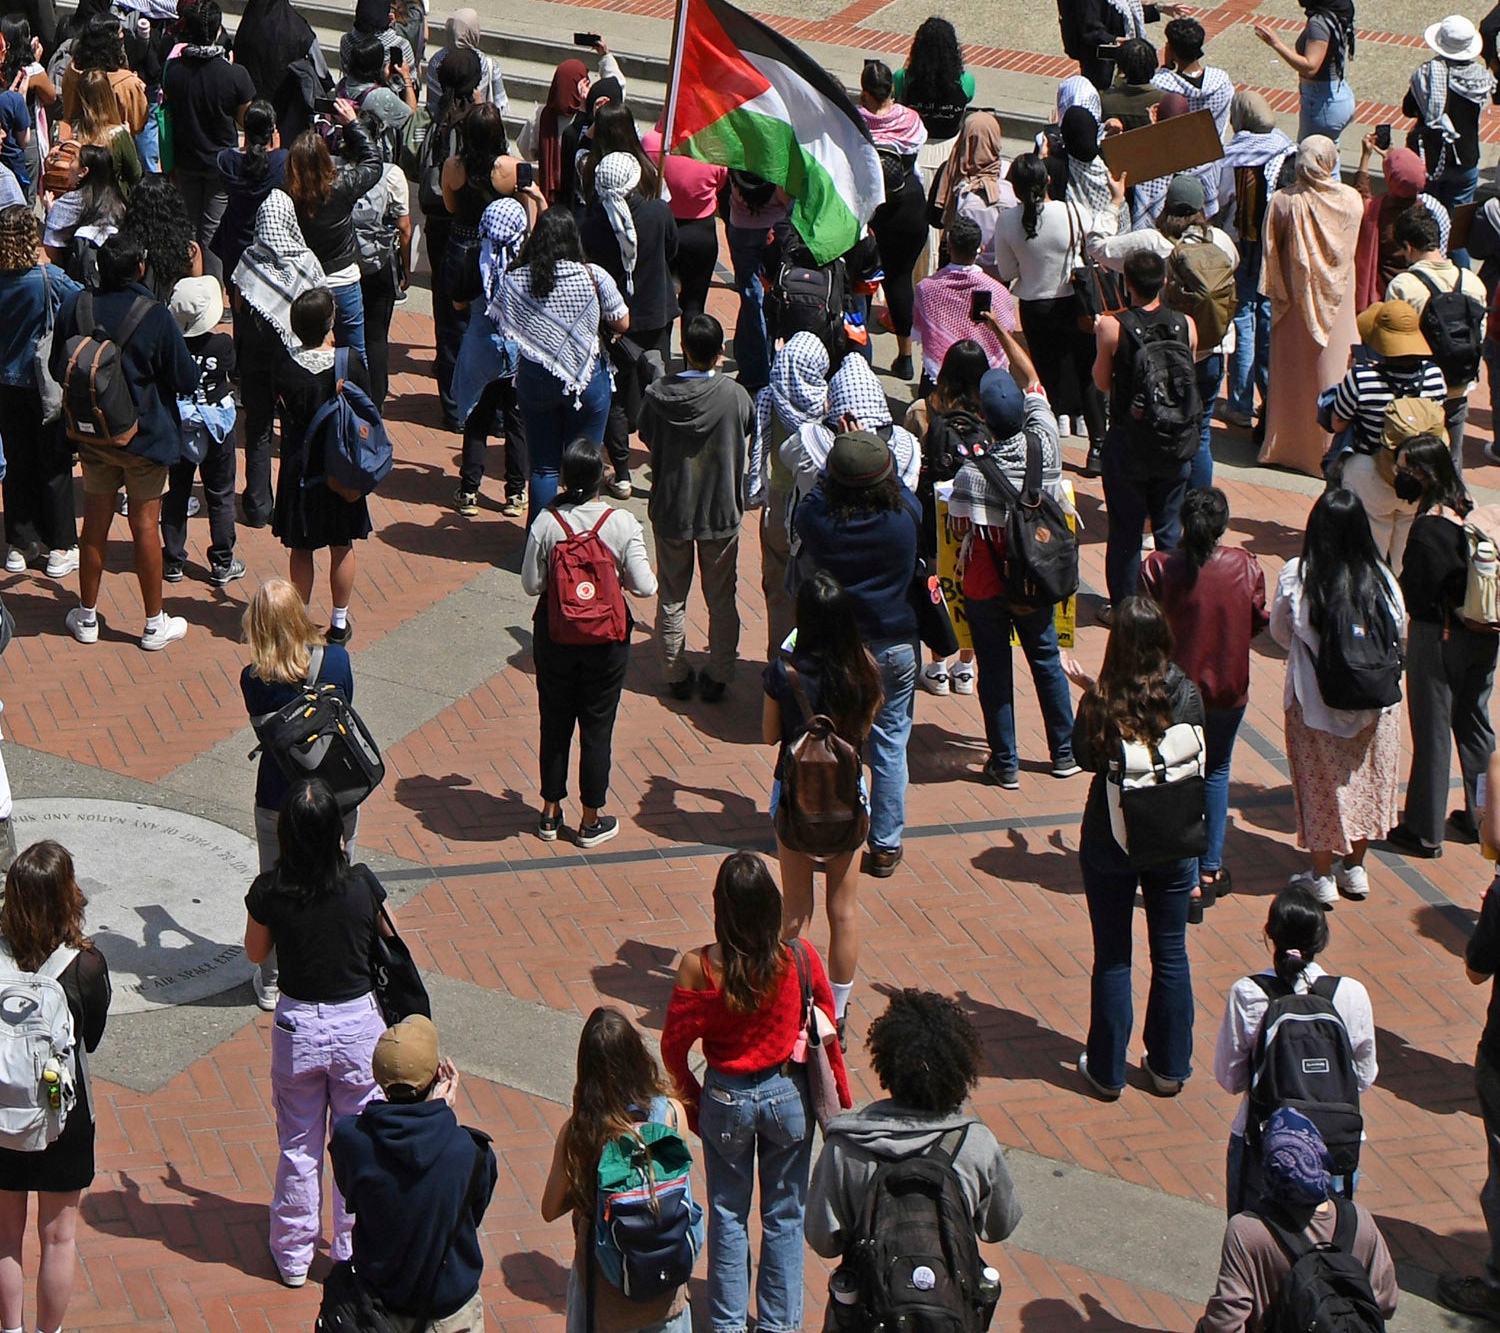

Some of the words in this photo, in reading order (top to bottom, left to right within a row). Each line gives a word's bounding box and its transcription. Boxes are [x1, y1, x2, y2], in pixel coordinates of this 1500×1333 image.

[43, 813, 71, 822] AND
[77, 813, 127, 826] NATION
[134, 820, 160, 830] ANY
[163, 827, 179, 836] OF
[178, 833, 212, 848] PART
[153, 976, 177, 988] AIR
[178, 960, 217, 980] SPACE
